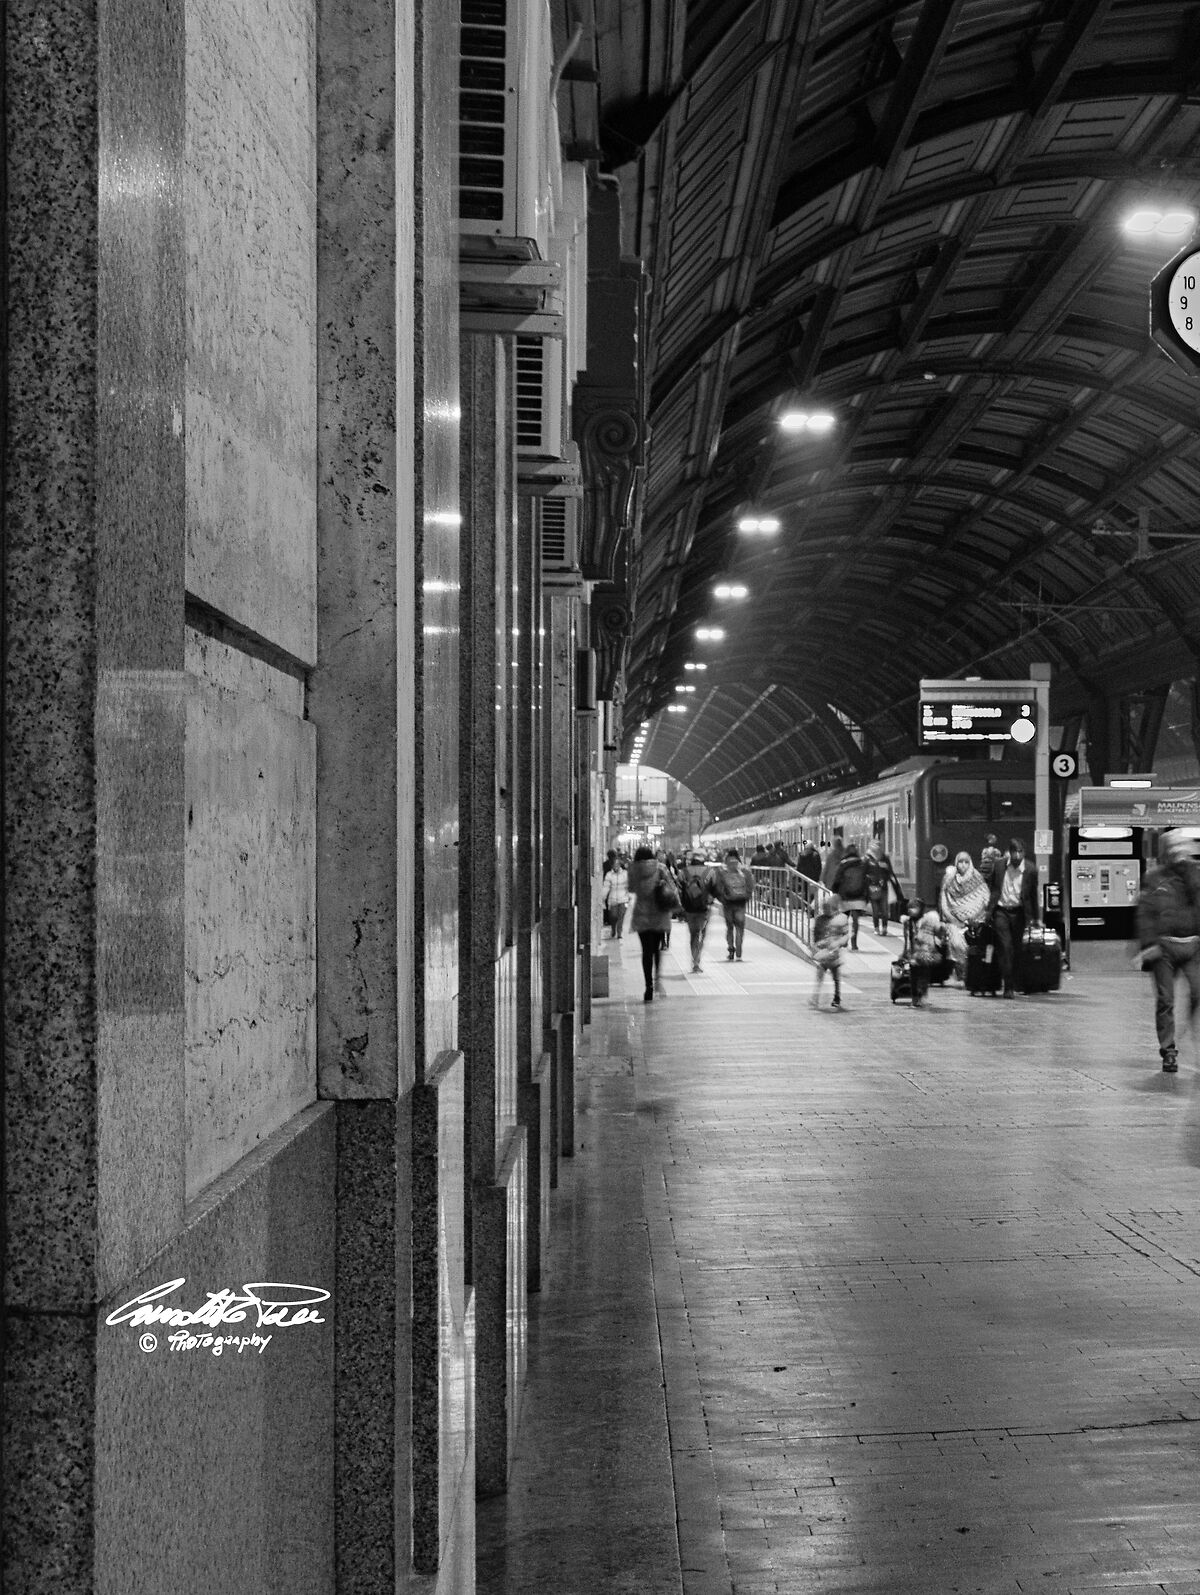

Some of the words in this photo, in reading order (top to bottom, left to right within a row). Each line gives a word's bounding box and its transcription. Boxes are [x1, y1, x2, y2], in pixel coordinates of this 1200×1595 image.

[1183, 275, 1196, 289] 10
[1180, 296, 1188, 309] 9
[1185, 317, 1193, 330] 8
[1058, 758, 1070, 773] 3
